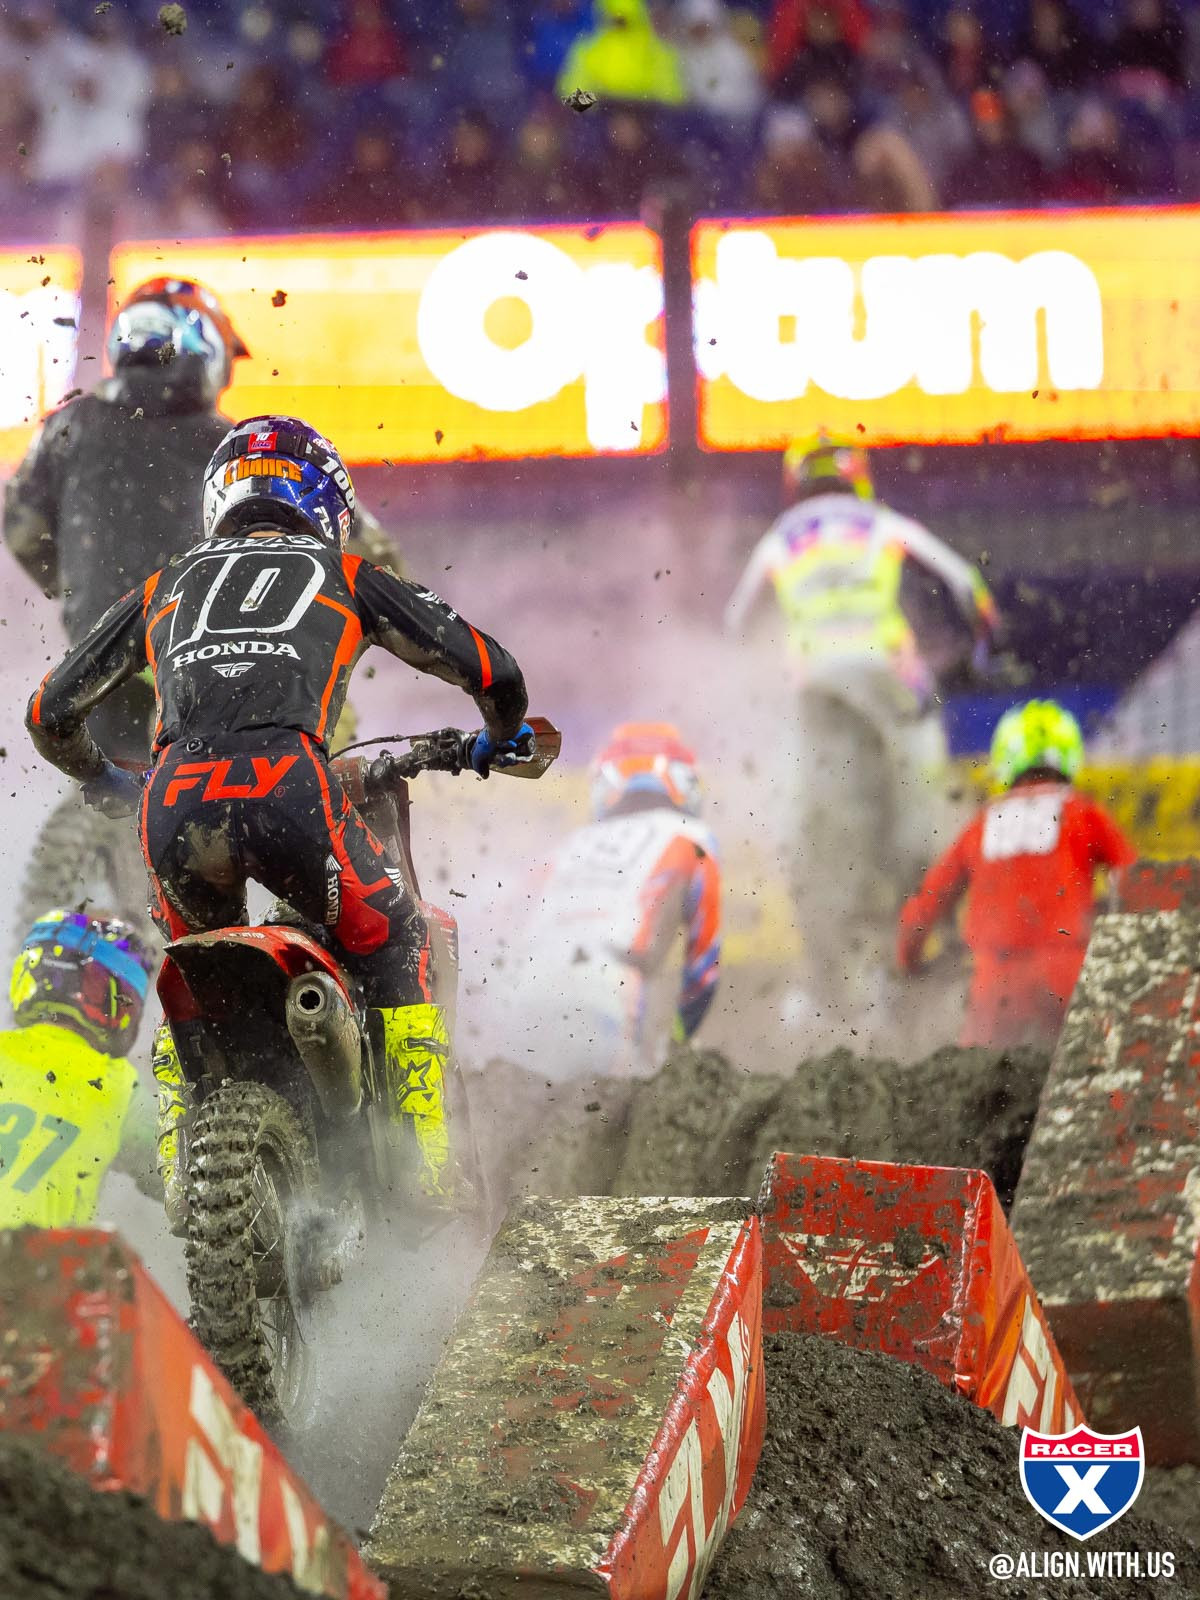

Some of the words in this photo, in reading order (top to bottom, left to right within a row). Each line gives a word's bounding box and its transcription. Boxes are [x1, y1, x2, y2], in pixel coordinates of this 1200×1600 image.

[166, 551, 325, 657] 10
[172, 641, 301, 671] HONDA
[163, 756, 300, 806] FLY
